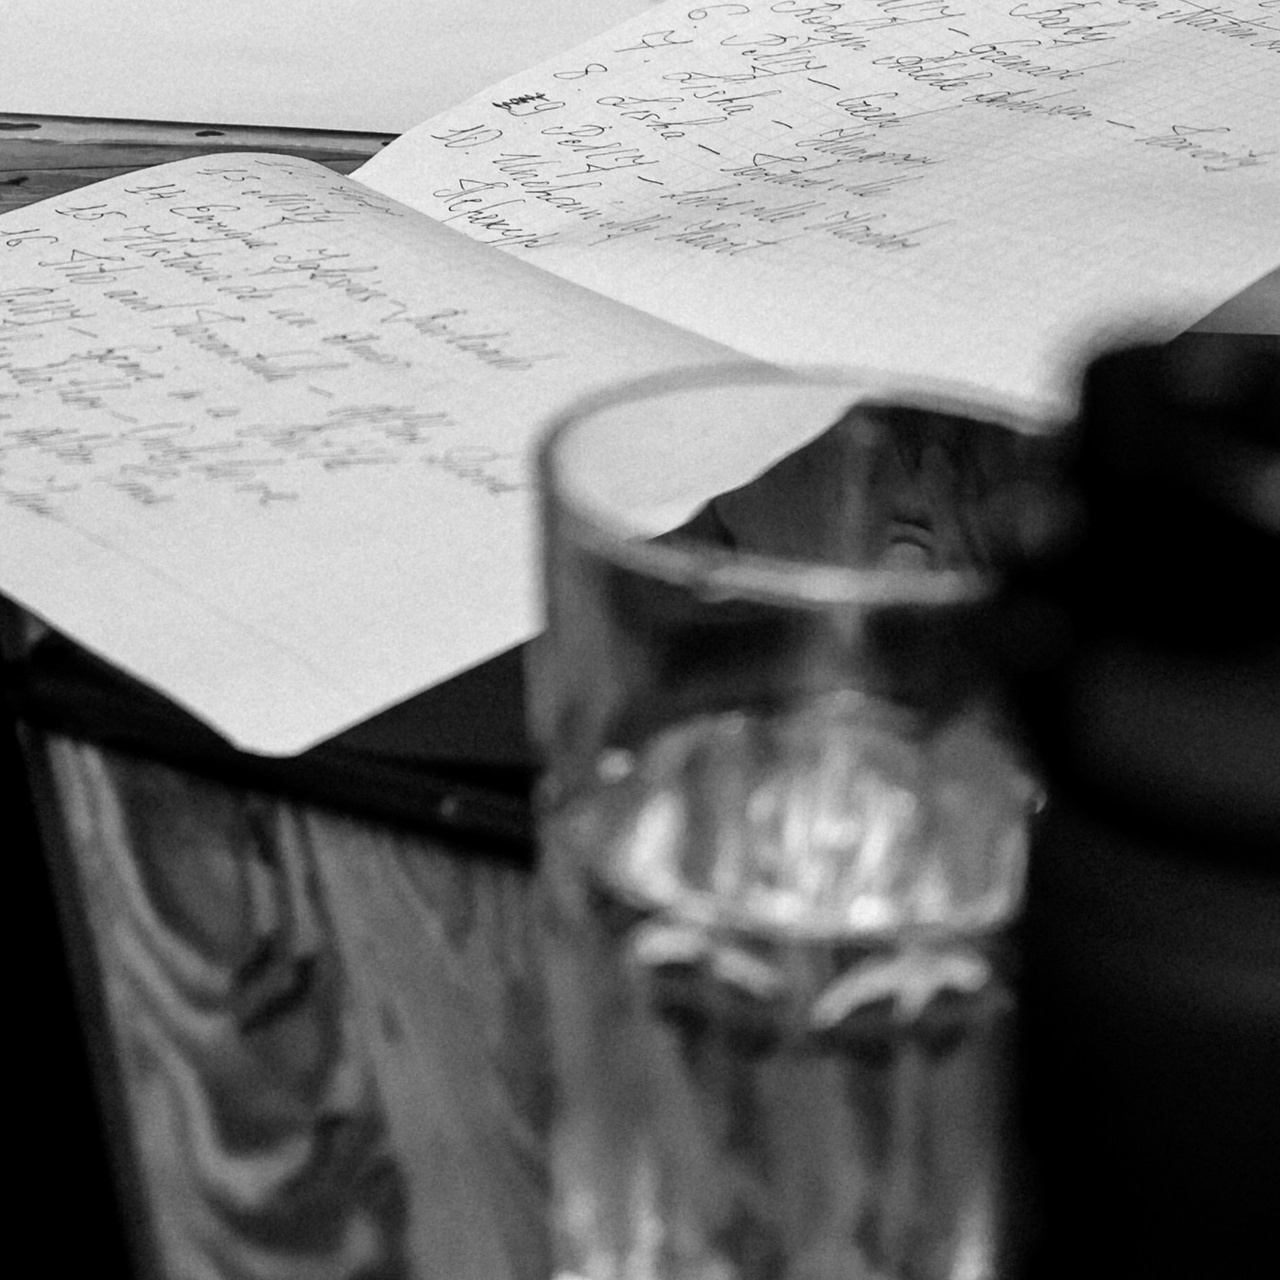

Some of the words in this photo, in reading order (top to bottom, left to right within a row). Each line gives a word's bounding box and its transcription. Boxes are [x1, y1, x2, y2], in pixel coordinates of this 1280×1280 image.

[771, 0, 907, 51] Robyn
[872, 55, 992, 91] Adele
[1009, 0, 1130, 49] Baby
